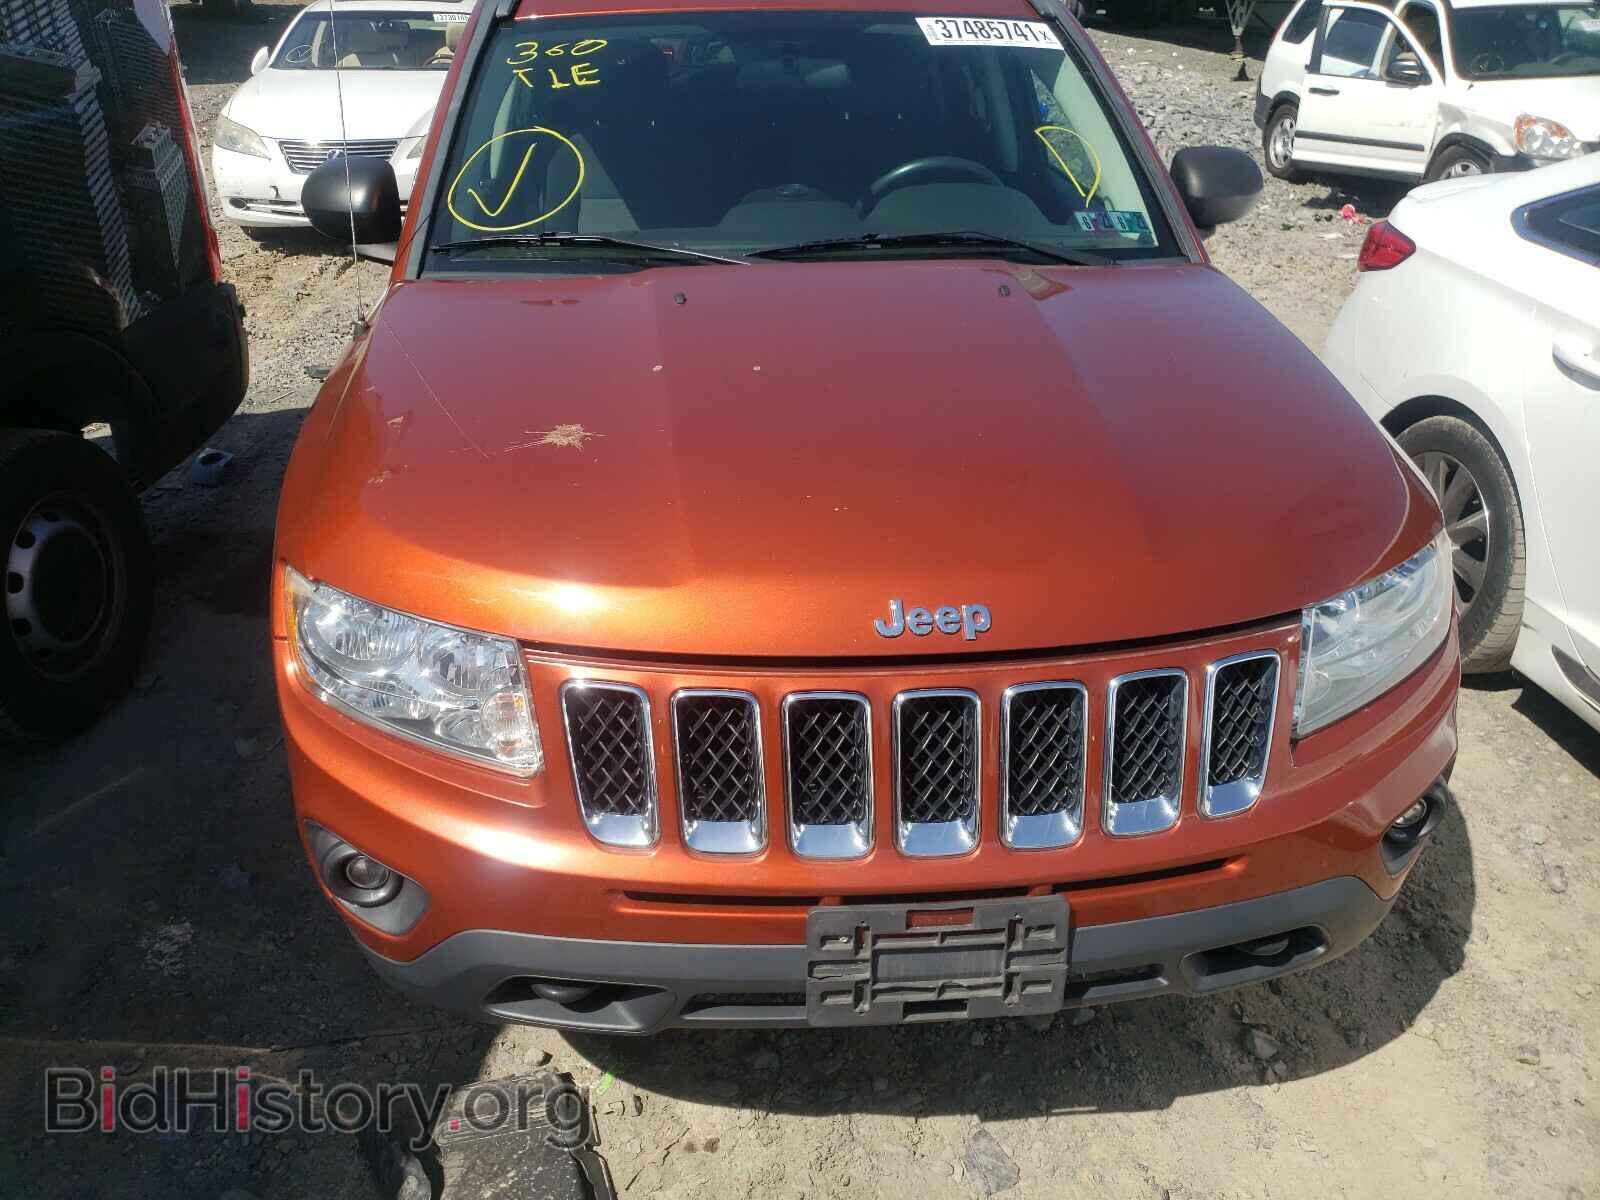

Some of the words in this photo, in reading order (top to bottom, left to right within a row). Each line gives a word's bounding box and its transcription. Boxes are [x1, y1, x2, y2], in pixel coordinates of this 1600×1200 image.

[934, 19, 1041, 42] 37485741
[506, 39, 608, 65] 360
[873, 598, 992, 641] Jeep
